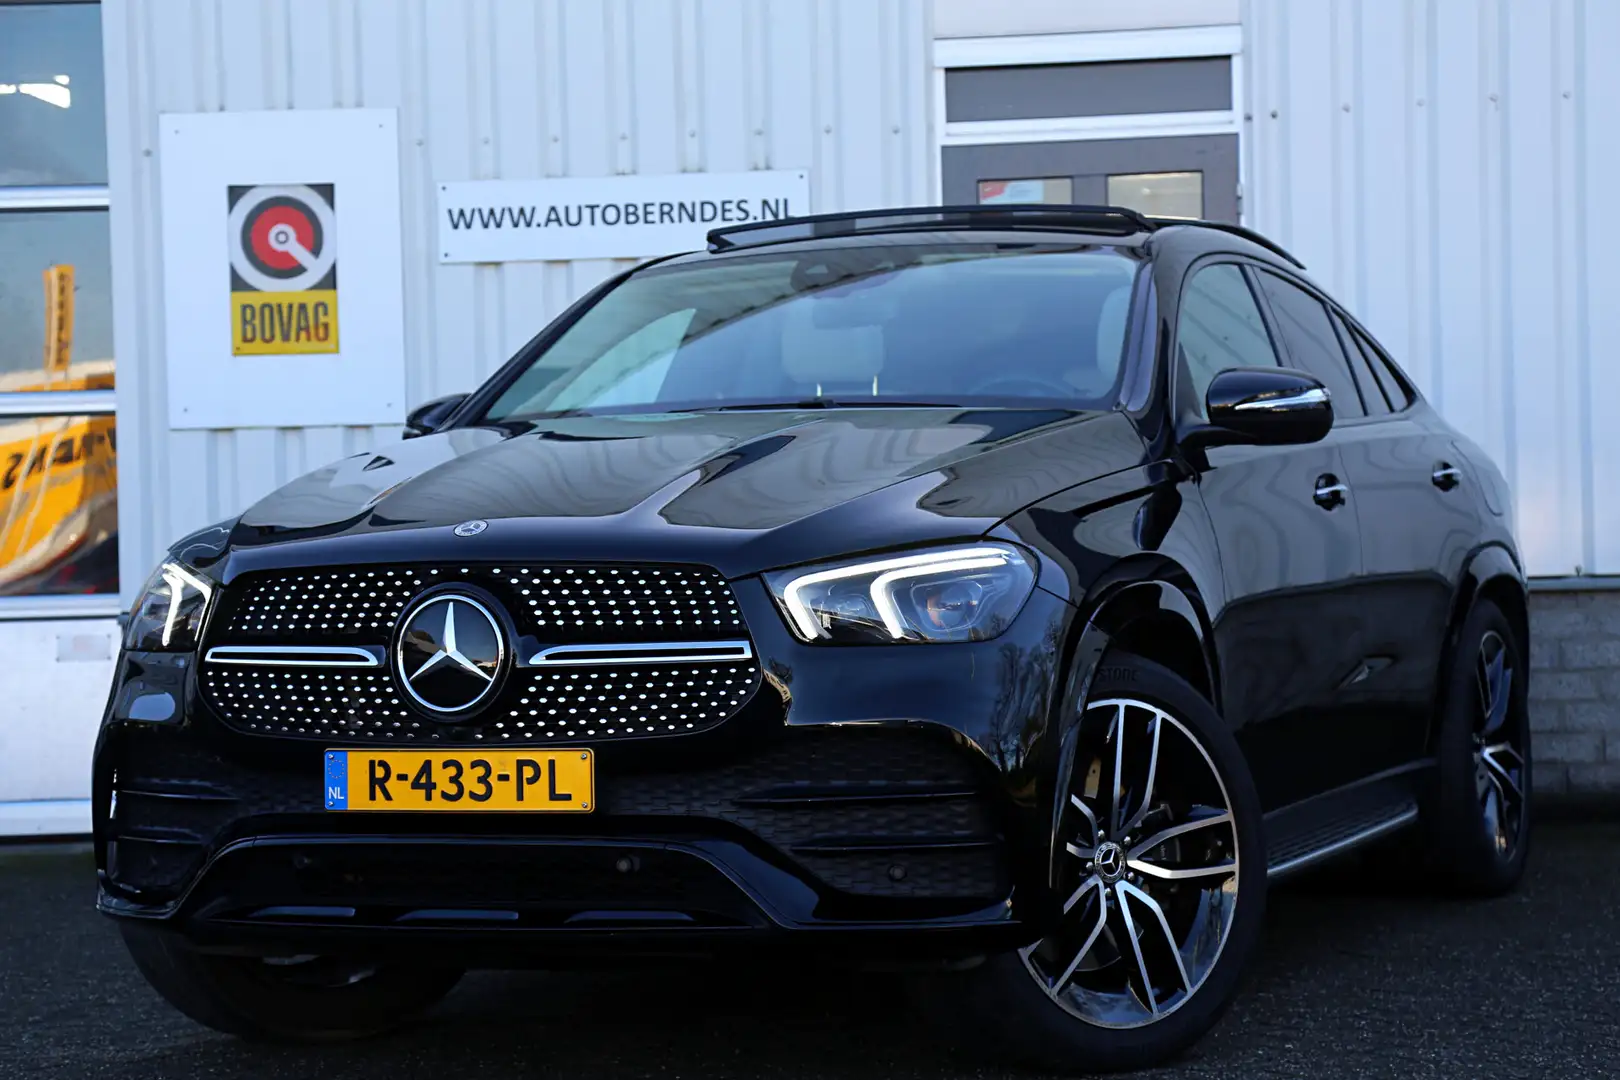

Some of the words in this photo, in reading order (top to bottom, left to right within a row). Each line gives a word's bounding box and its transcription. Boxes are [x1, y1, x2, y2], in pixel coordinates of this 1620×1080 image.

[447, 198, 792, 230] WWW.AUTOBERNDES.NL
[240, 301, 329, 343] BOVAG
[328, 786, 344, 800] NL
[368, 759, 572, 802] R-433-PL
